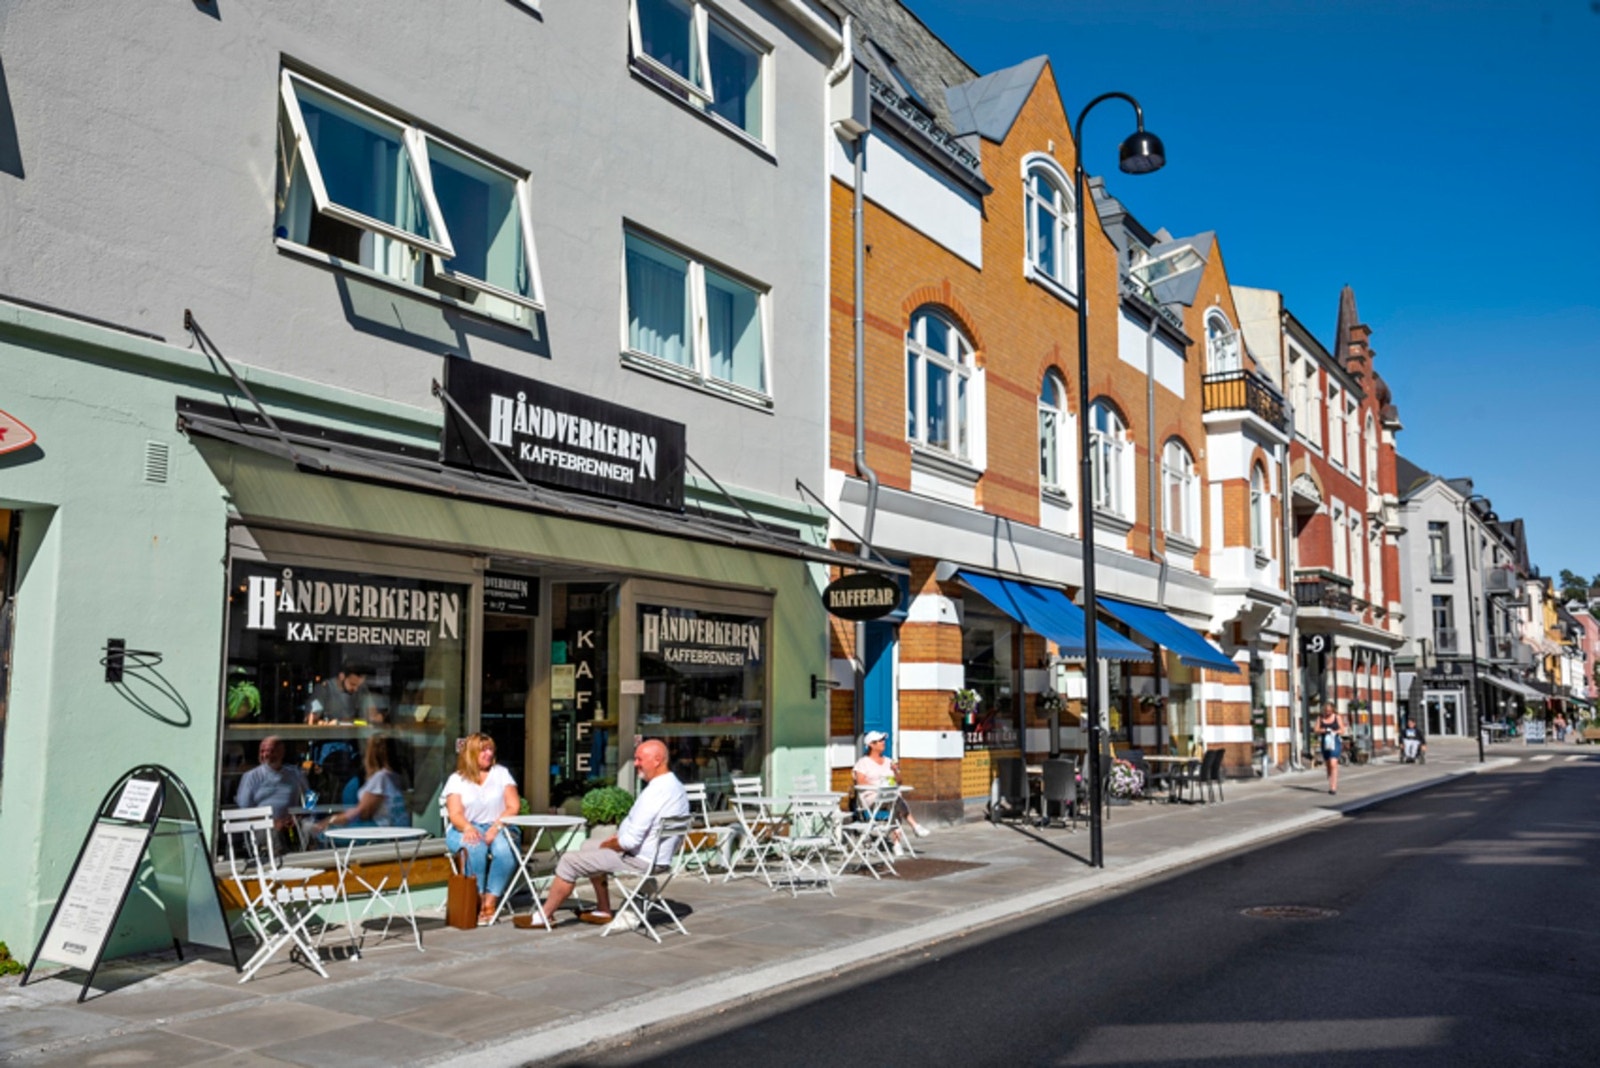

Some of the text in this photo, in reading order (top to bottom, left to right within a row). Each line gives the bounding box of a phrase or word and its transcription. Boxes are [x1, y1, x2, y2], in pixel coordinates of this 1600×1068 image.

[489, 391, 658, 481] HÅNDVERKEREN
[520, 446, 634, 484] KAFFEBRENNERI
[246, 568, 460, 641] HÅNDVERKEREN
[829, 587, 894, 608] KAFFEBAR
[287, 622, 431, 647] KAFFEBRENNERI
[643, 608, 760, 661] HÅNDVERKEREN
[664, 647, 745, 666] KAFFEBRENNERI
[575, 629, 594, 772] KAFFE
